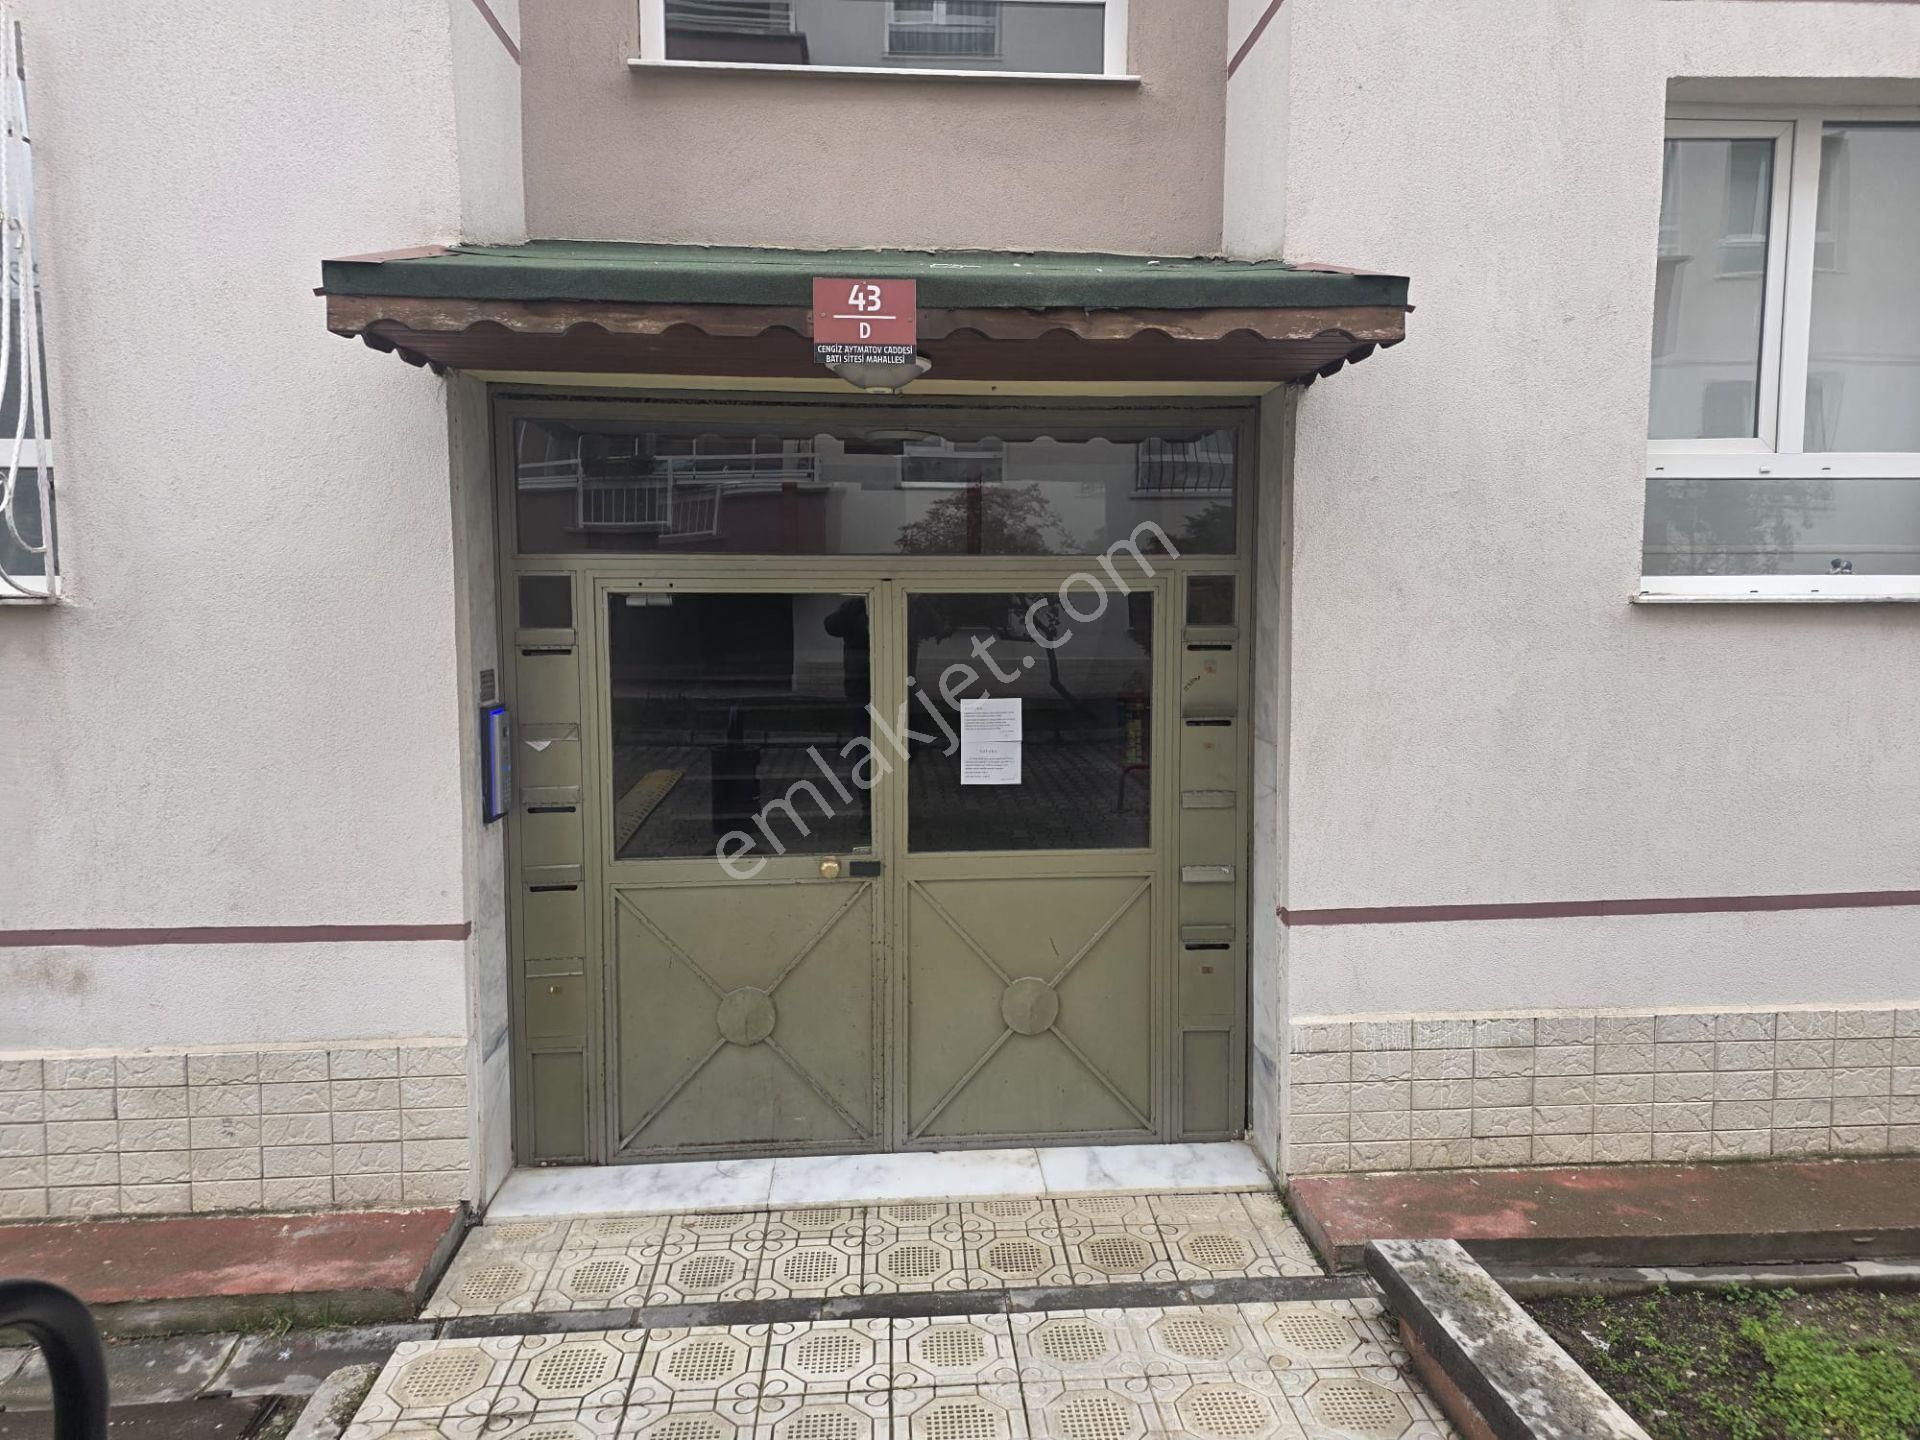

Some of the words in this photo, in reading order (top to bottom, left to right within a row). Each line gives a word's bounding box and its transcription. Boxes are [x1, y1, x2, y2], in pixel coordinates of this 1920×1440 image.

[848, 284, 881, 312] 43
[859, 322, 871, 339] D
[817, 343, 842, 353] CENGİZ
[844, 345, 882, 354] AYTMATOV
[883, 345, 913, 354] CADDESİ
[826, 355, 842, 363] BATI
[843, 354, 864, 363] SİTESİ
[866, 355, 905, 364] MAHALLESİ
